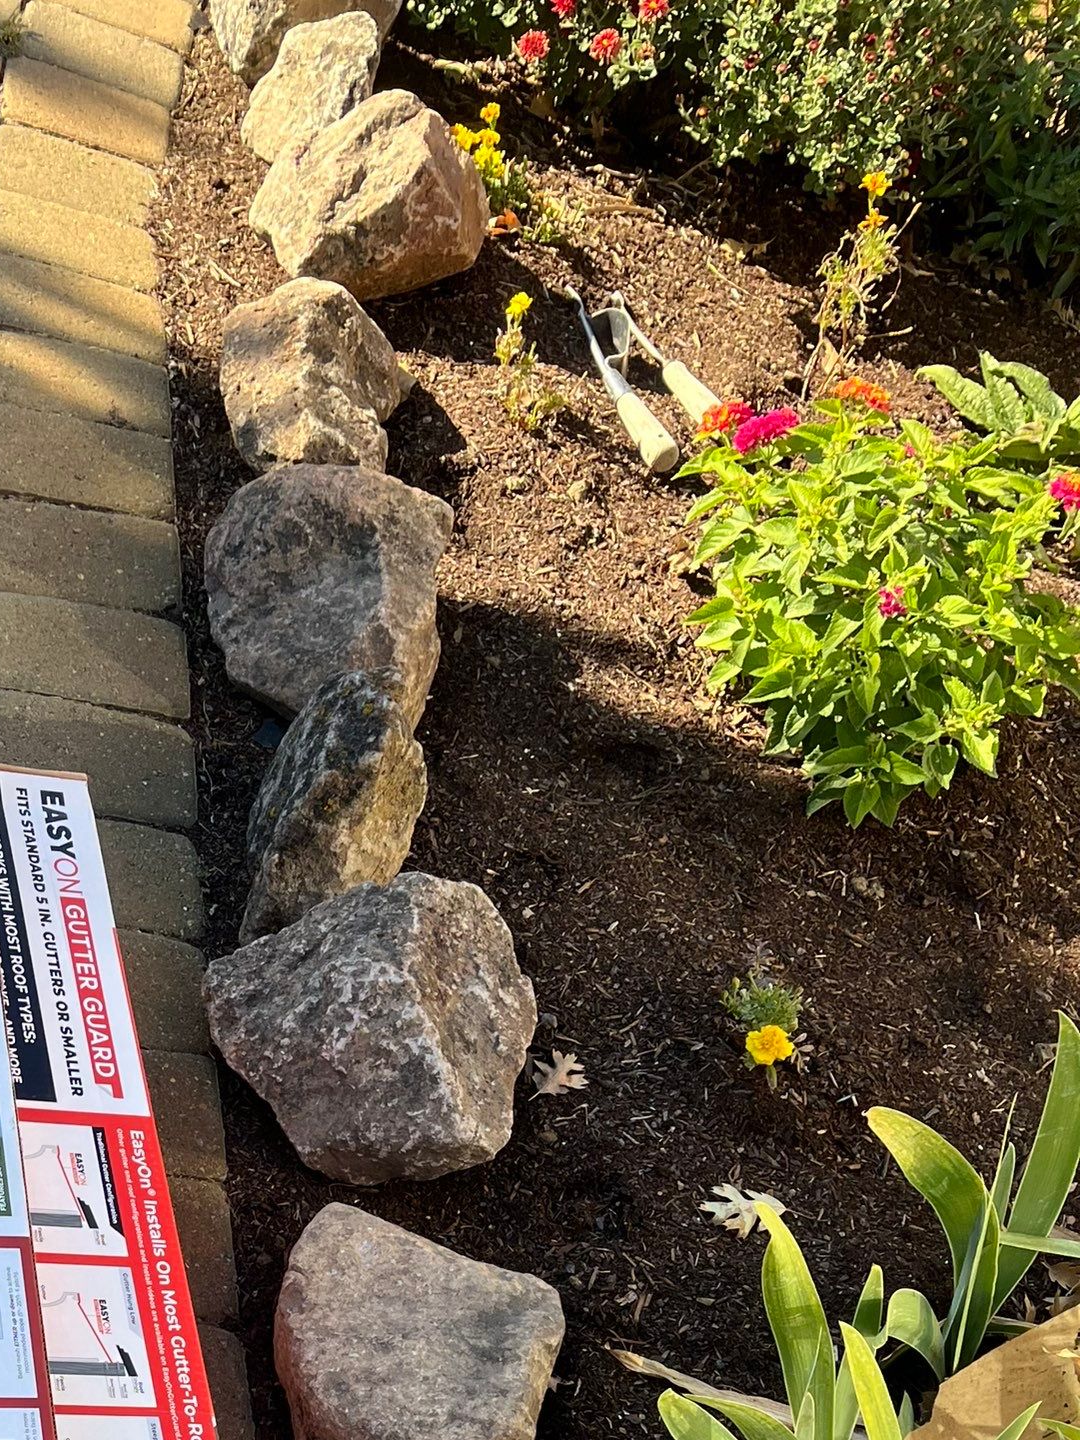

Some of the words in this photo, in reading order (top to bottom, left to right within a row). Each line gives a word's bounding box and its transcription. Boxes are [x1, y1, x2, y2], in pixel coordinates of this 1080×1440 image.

[14, 787, 31, 816] FITS
[21, 819, 46, 892] STANDARD
[38, 789, 82, 893] EASYON
[35, 896, 48, 904] 5
[38, 908, 52, 927] IN.
[2, 914, 21, 952] MOST
[62, 904, 100, 991] GUTTER
[9, 955, 28, 993] ROOF
[42, 931, 65, 996] GUTTERS
[17, 995, 36, 1043] TYPES:
[55, 1000, 70, 1021] OR
[2, 1018, 15, 1044] AND
[80, 995, 116, 1077] GUARD
[6, 1048, 22, 1083] MORE
[59, 1026, 83, 1096] SMALLER
[143, 1198, 168, 1256] Installs
[155, 1261, 173, 1284] On
[160, 1288, 182, 1330] Most
